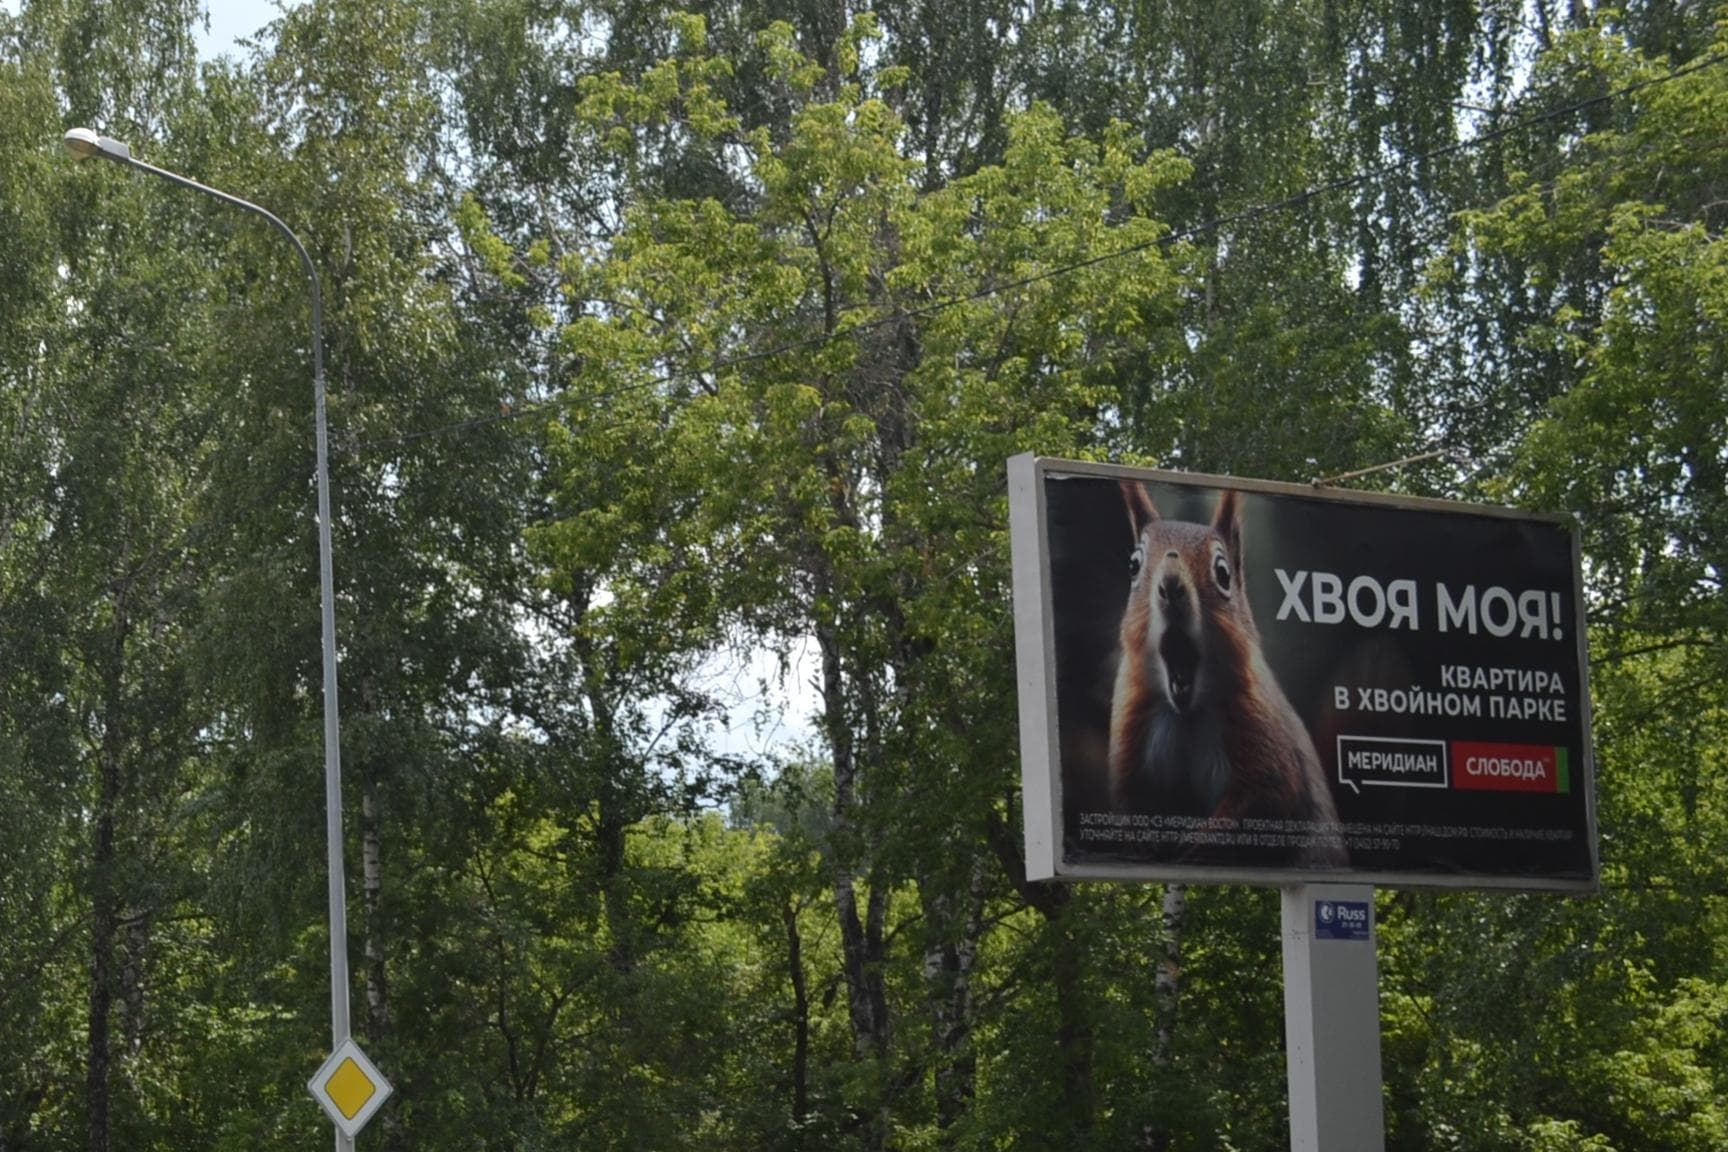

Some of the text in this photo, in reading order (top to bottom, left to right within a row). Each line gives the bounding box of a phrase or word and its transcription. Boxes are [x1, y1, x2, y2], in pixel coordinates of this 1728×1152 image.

[1274, 568, 1563, 641] ХВОЯ МОЯ!
[1440, 664, 1565, 695] КВАРТИРА
[1334, 686, 1567, 722] В ХВОЙНОМ ПАРКЕ
[1348, 751, 1437, 773] МЕРИДИАН
[1466, 756, 1546, 780] СЛОБОДА
[1337, 905, 1366, 921] Russ
